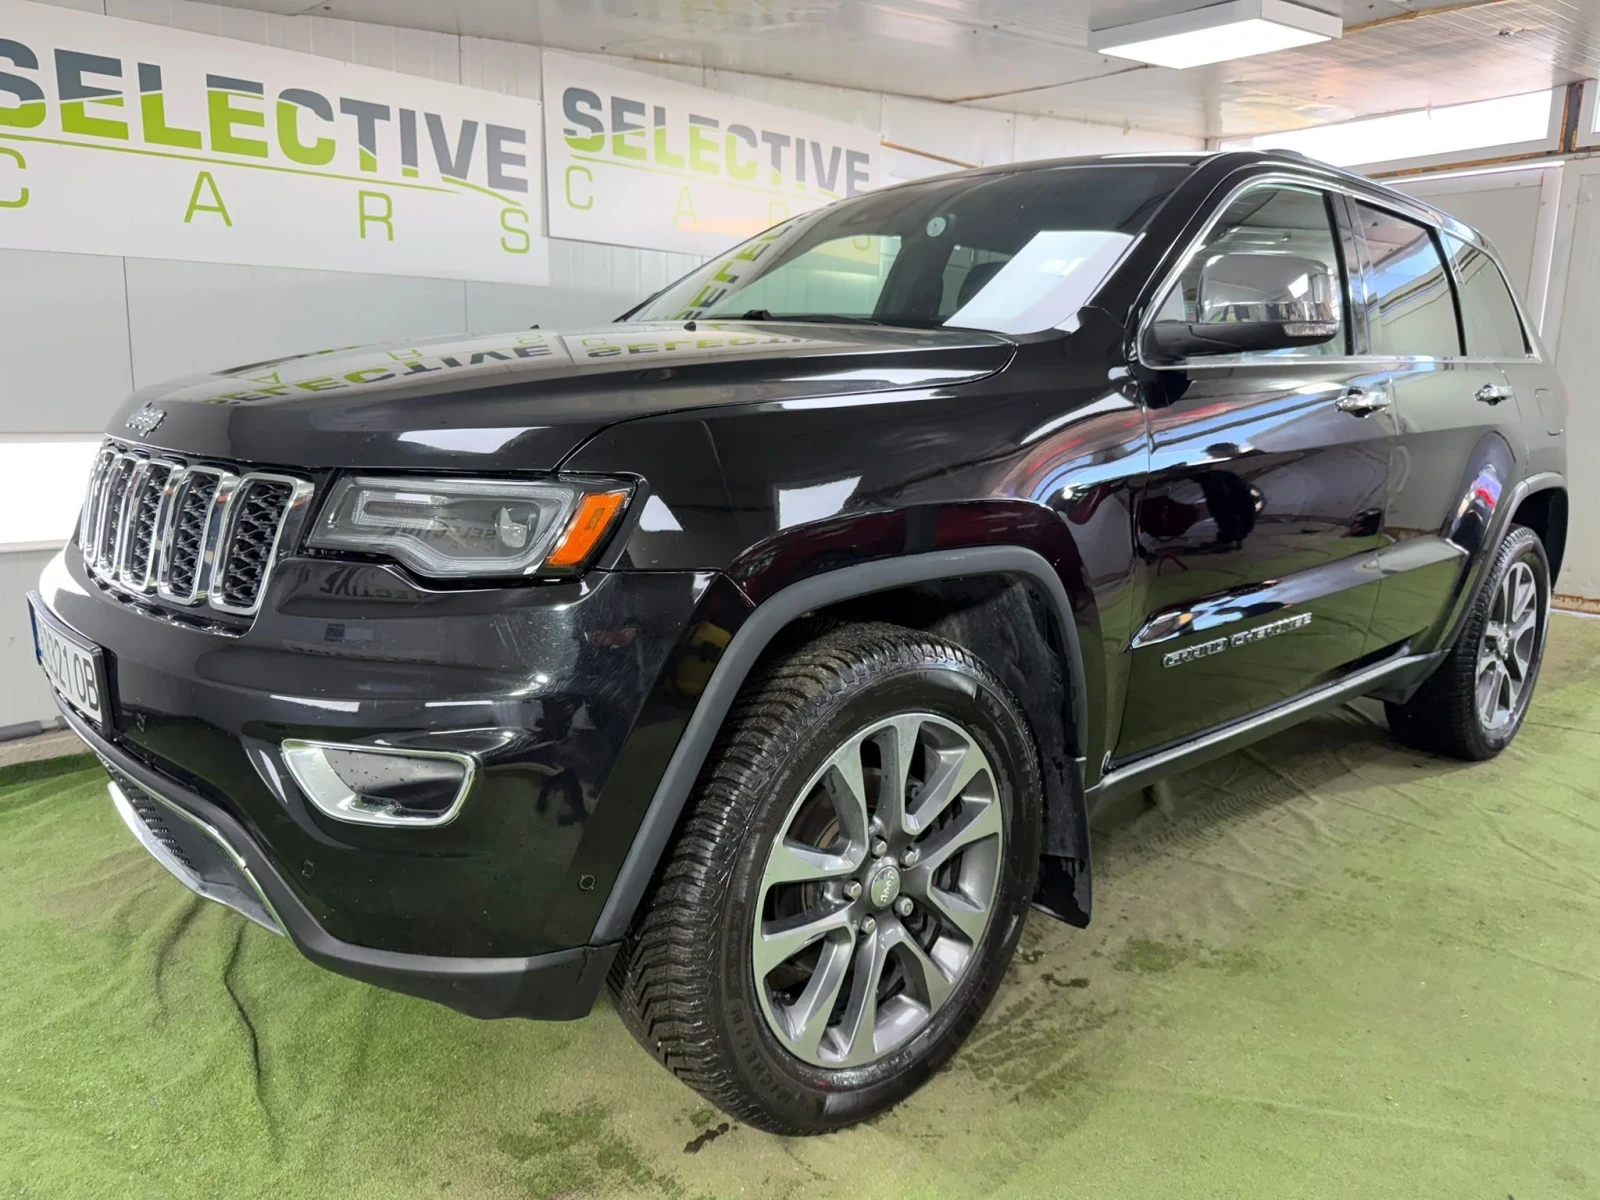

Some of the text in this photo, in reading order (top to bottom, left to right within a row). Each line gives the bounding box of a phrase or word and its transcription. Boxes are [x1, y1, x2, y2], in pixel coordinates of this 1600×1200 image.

[562, 86, 870, 199] SELECTIVE
[1162, 611, 1313, 669] GRAND CHEROKEE
